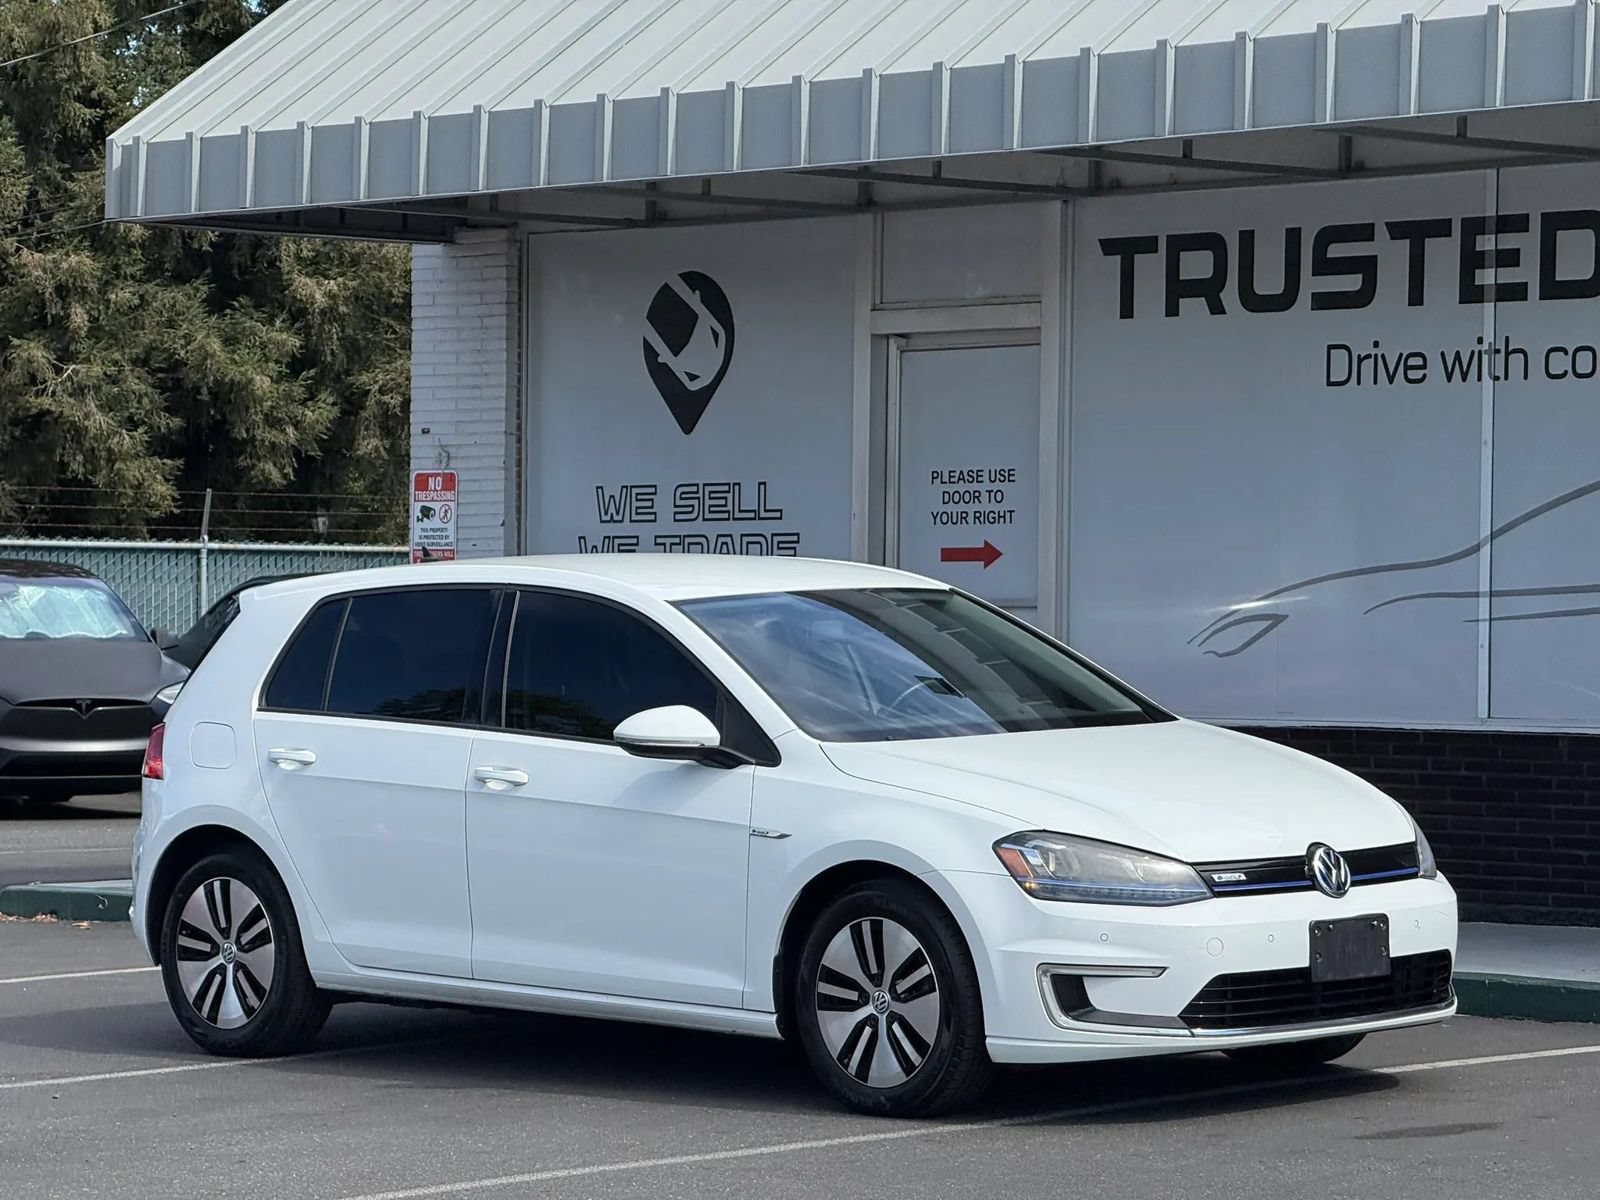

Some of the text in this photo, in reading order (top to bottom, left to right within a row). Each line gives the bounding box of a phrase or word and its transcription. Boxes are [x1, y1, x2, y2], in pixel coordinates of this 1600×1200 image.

[1098, 209, 1600, 319] TRUSTED
[1326, 335, 1597, 386] Drive with co
[428, 476, 442, 490] NO
[931, 468, 1016, 485] PLEASE USE
[415, 491, 455, 501] TRESPASSING
[595, 481, 783, 523] WE SELL
[942, 489, 1004, 505] DOOR TO
[931, 509, 1015, 526] YOUR RIGHT
